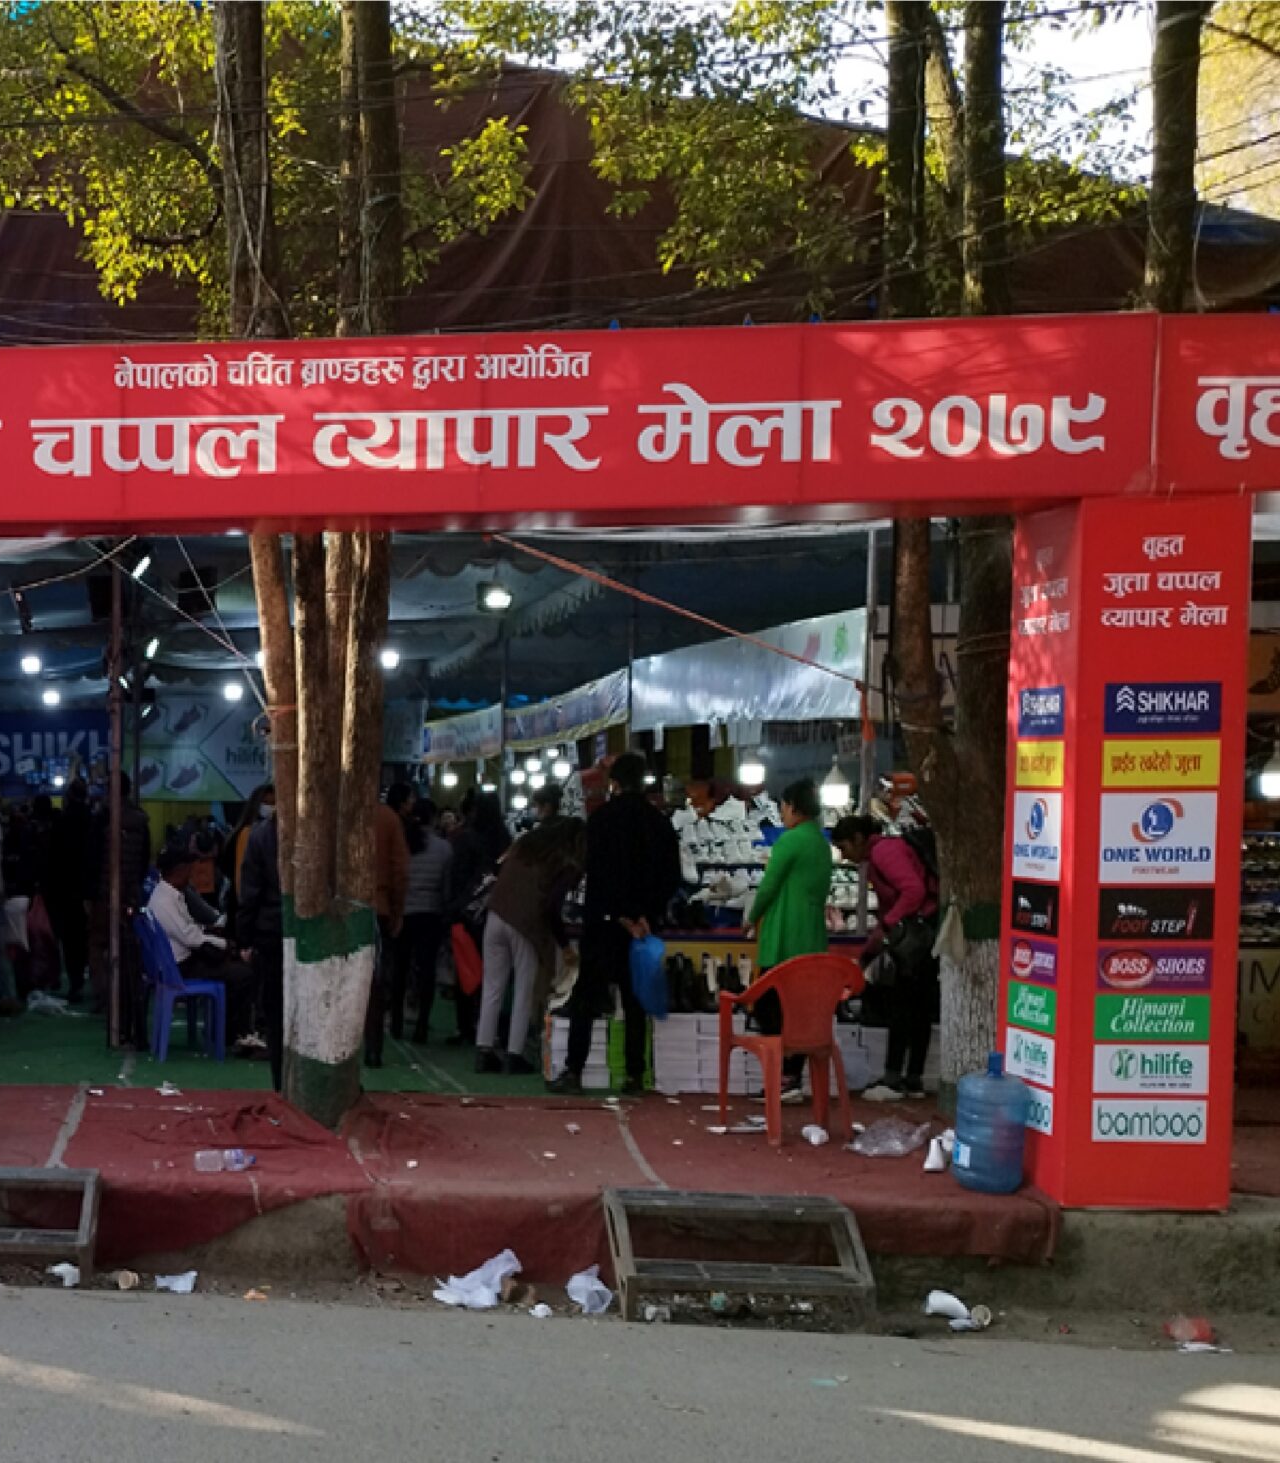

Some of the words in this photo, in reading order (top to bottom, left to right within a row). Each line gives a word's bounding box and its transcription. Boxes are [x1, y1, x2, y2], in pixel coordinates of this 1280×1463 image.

[114, 353, 218, 390] नेपालको
[227, 351, 293, 387] चर्चित
[412, 355, 467, 391] द्वारा
[474, 343, 592, 380] आयोजित
[1195, 375, 1280, 460] वृह
[29, 414, 285, 477] चप्पल
[313, 405, 609, 471] व्यापार
[637, 382, 842, 466] मेला
[870, 392, 1106, 459] २०७९
[1142, 534, 1185, 560] वृहत
[1156, 571, 1222, 591] चप्पल
[1101, 607, 1173, 628] व्यापार
[1179, 600, 1229, 627] मेला
[1137, 690, 1210, 713] SHIKHAR
[1103, 847, 1140, 862] ONE
[1144, 846, 1212, 862] WORLD
[1111, 917, 1148, 933] FOOT
[1150, 919, 1186, 933] STEP
[1109, 959, 1148, 974] BOSS
[1155, 958, 1206, 974] SHOES
[1120, 998, 1186, 1017] Himani
[1110, 1013, 1195, 1034] Collection
[1140, 1053, 1193, 1075] hilife
[1097, 1105, 1203, 1137] bamboo
